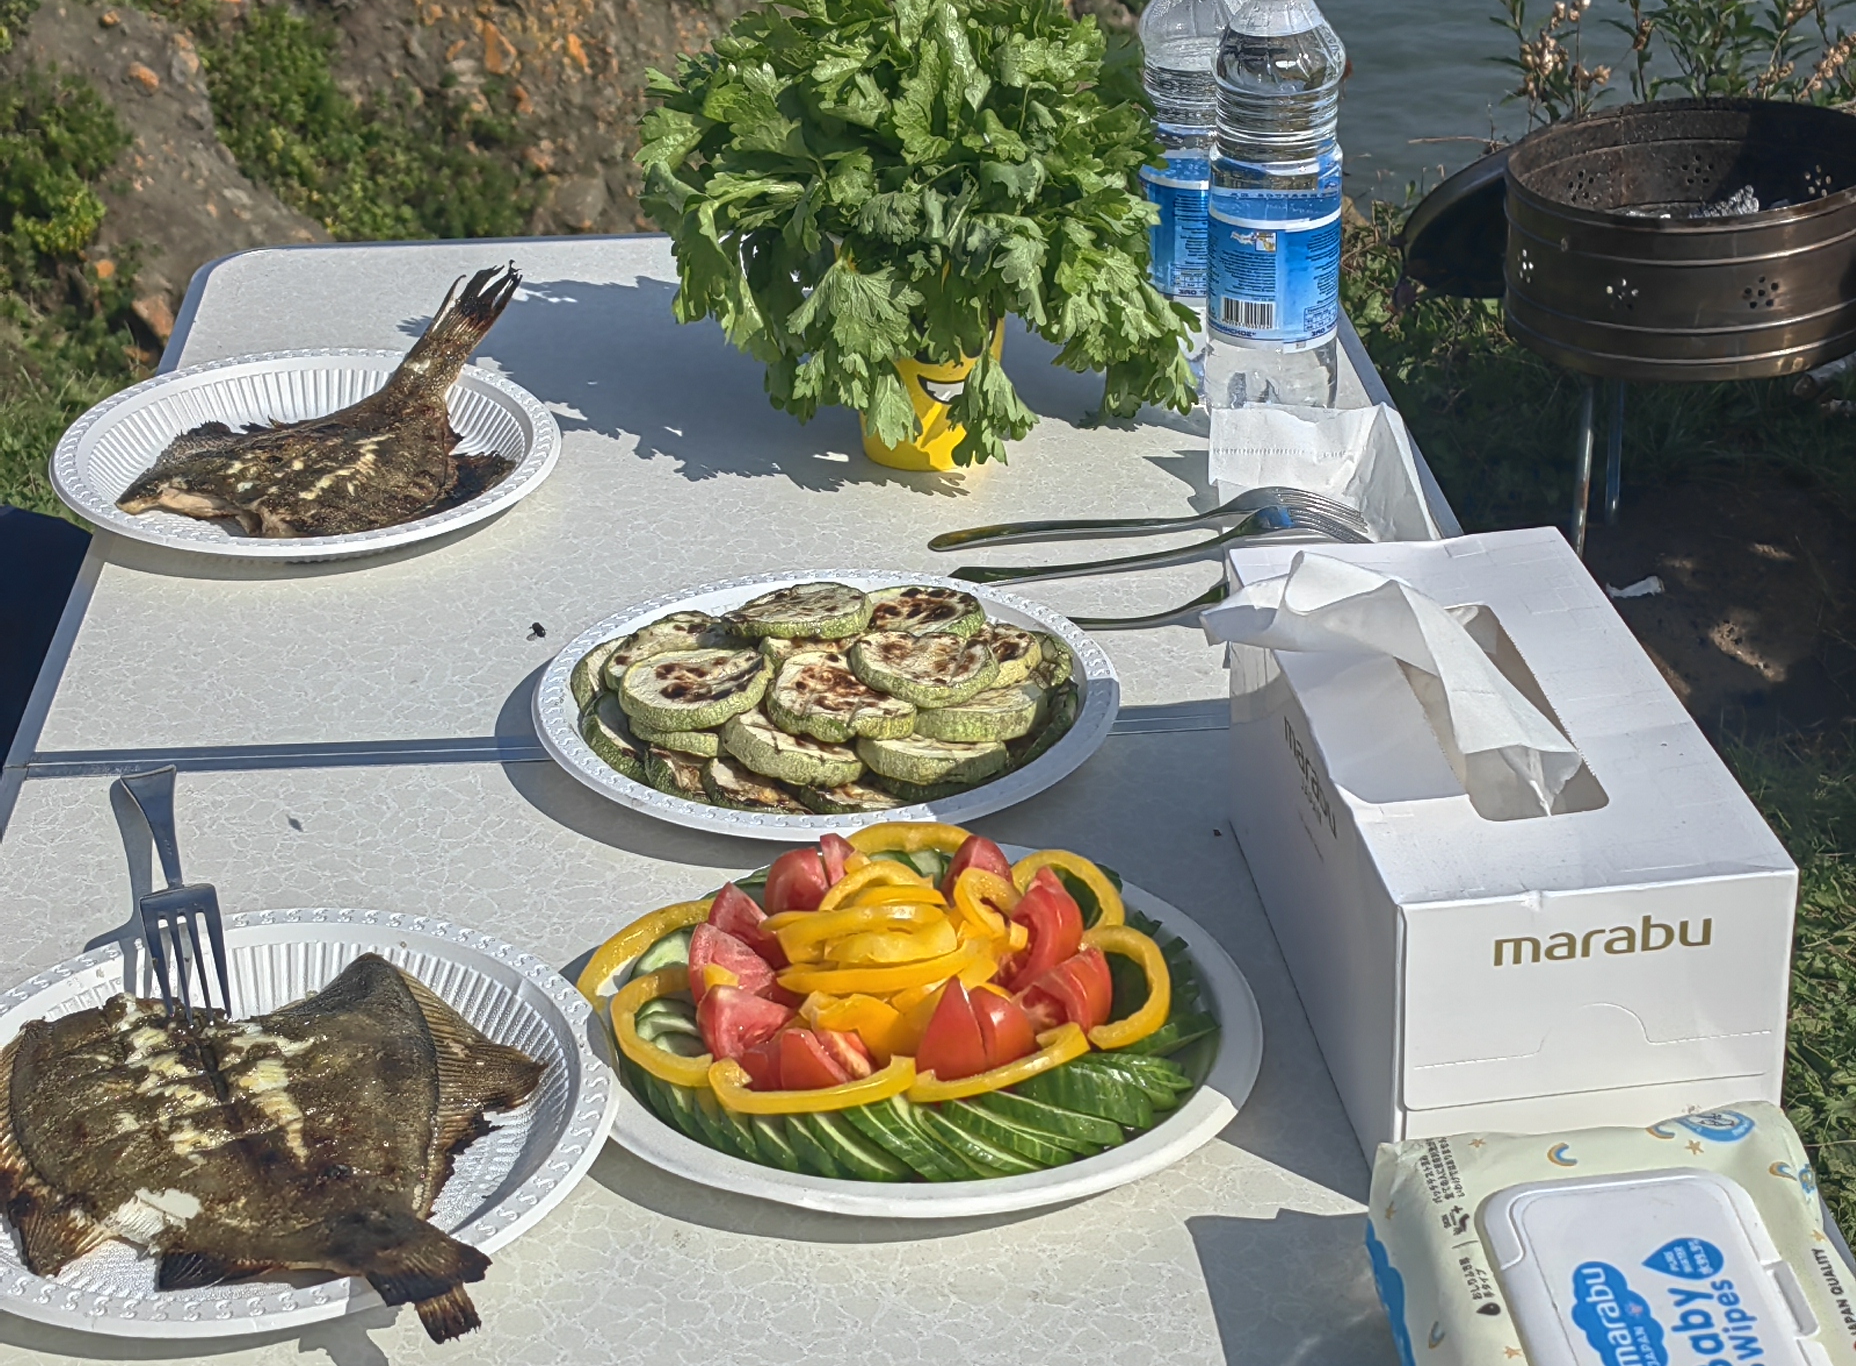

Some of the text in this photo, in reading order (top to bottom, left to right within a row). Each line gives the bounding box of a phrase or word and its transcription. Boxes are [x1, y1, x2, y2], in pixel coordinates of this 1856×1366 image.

[1283, 715, 1338, 840] marabu
[1493, 915, 1713, 968] marabu
[1811, 1248, 1844, 1295] QUALITY
